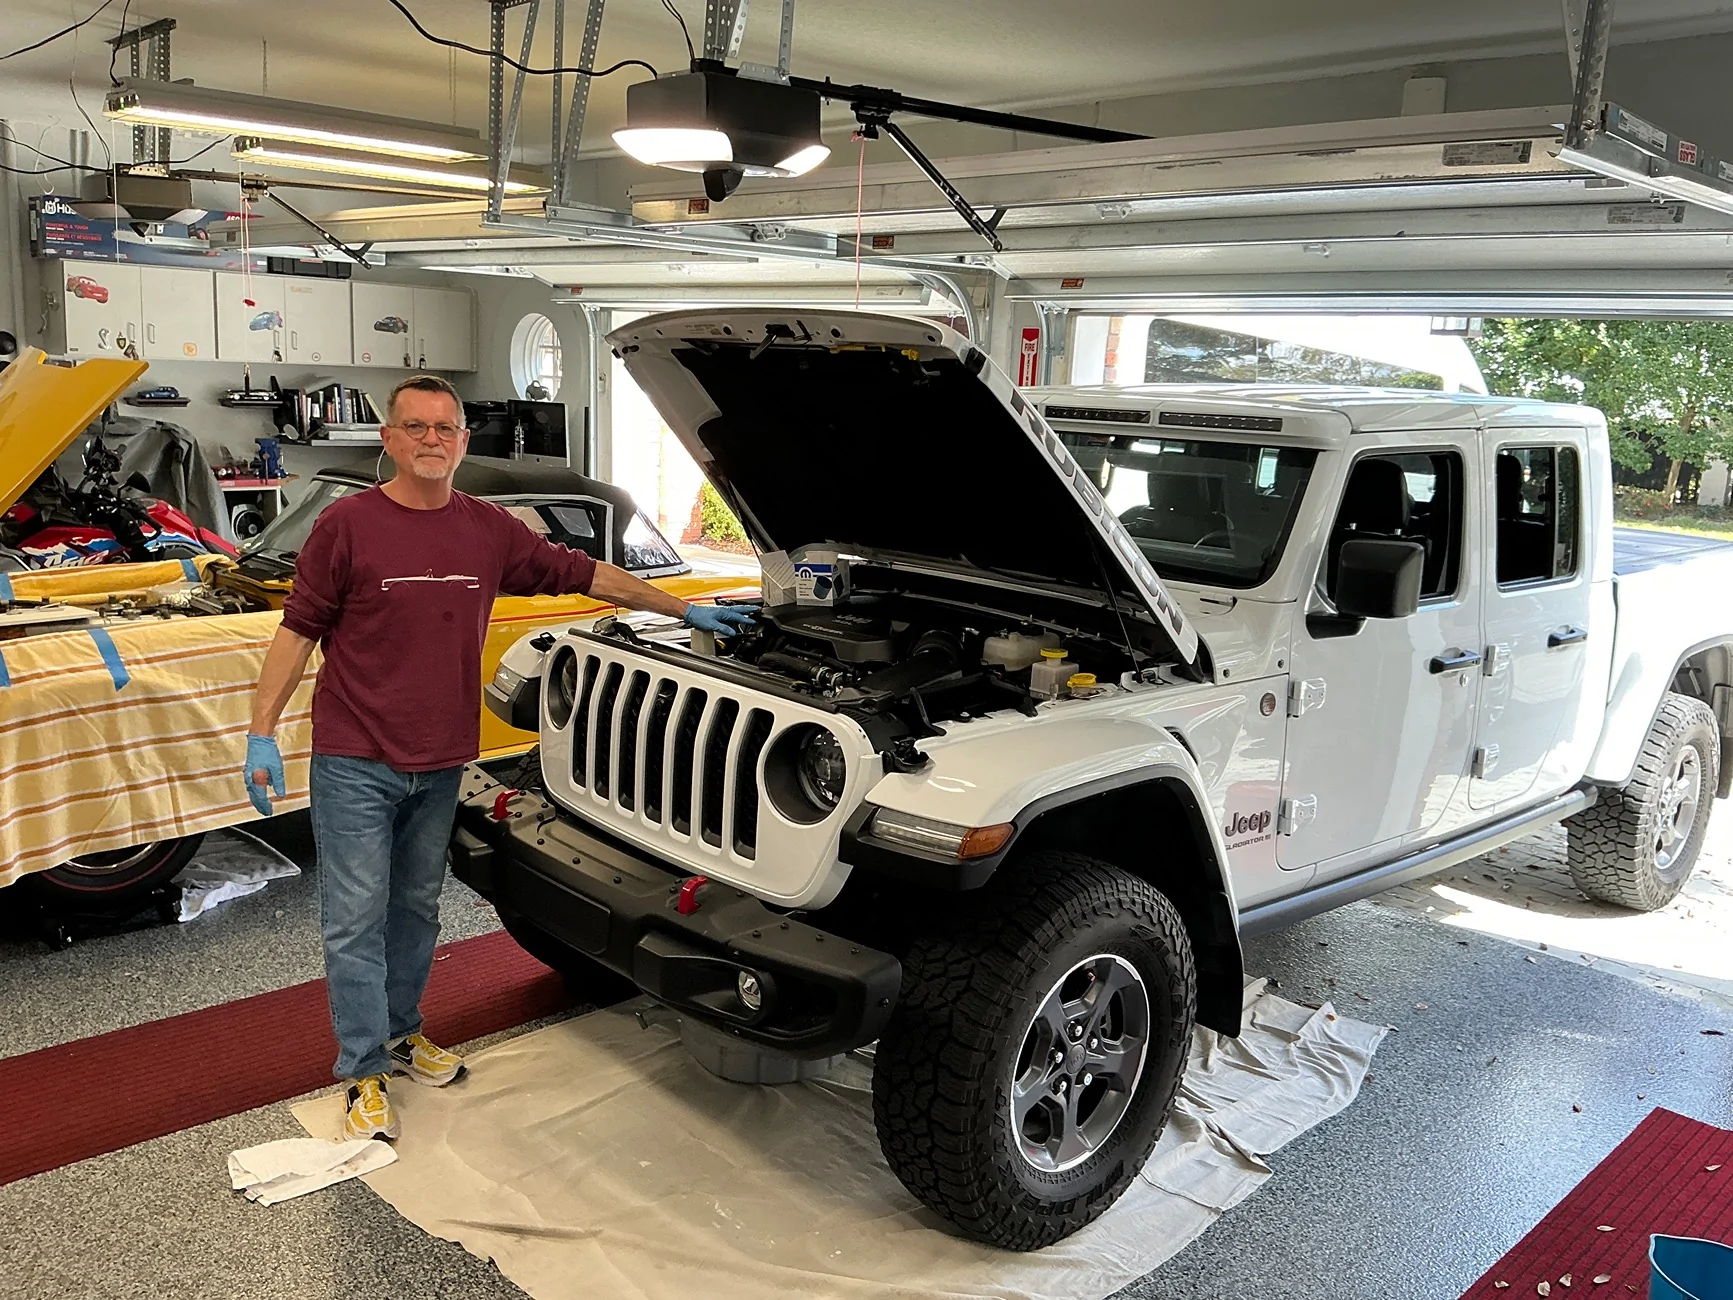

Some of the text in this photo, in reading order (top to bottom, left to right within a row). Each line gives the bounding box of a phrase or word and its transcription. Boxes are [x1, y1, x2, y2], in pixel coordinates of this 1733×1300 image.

[1024, 343, 1036, 352] FIRE
[1010, 388, 1184, 636] RUBICON
[1224, 810, 1272, 838] Jeep
